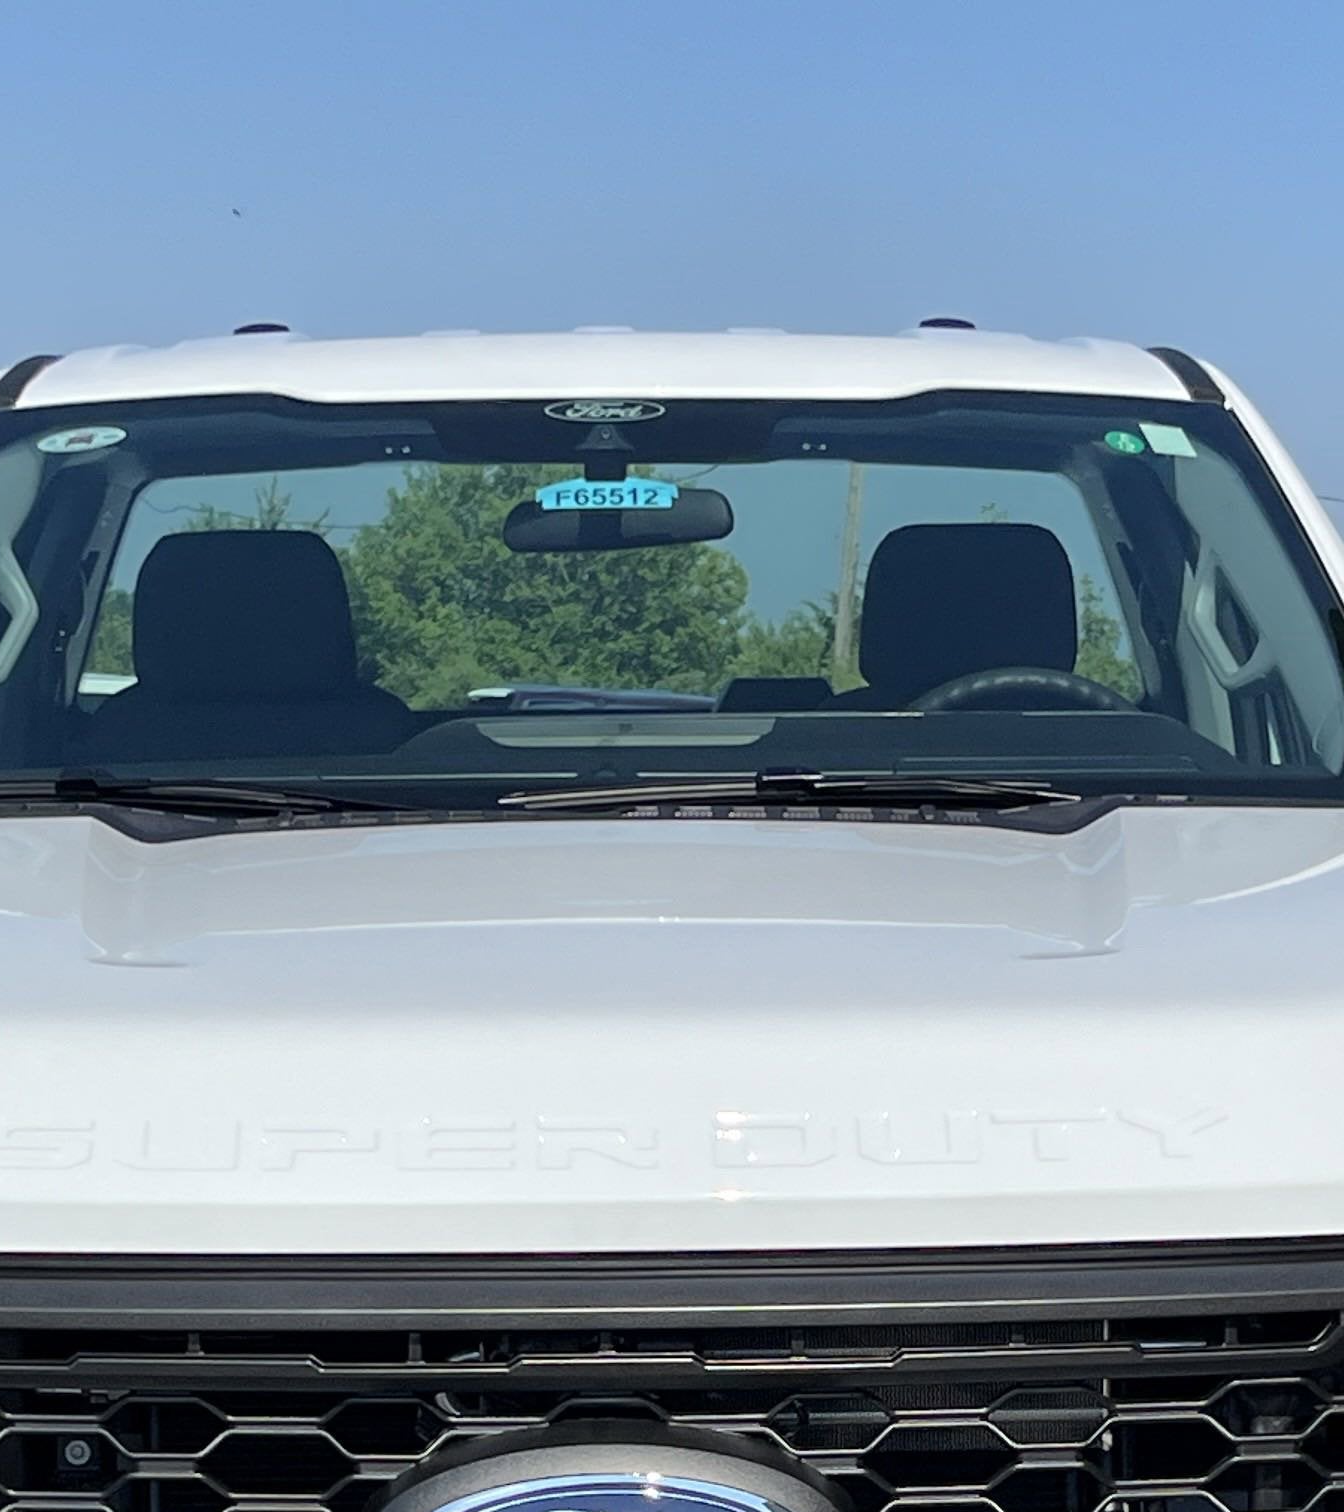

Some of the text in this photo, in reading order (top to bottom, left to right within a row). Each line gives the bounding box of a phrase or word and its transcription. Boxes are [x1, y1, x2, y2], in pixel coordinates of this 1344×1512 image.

[565, 400, 644, 418] Ford
[557, 488, 660, 506] F65512
[712, 1108, 1229, 1169] DUTY
